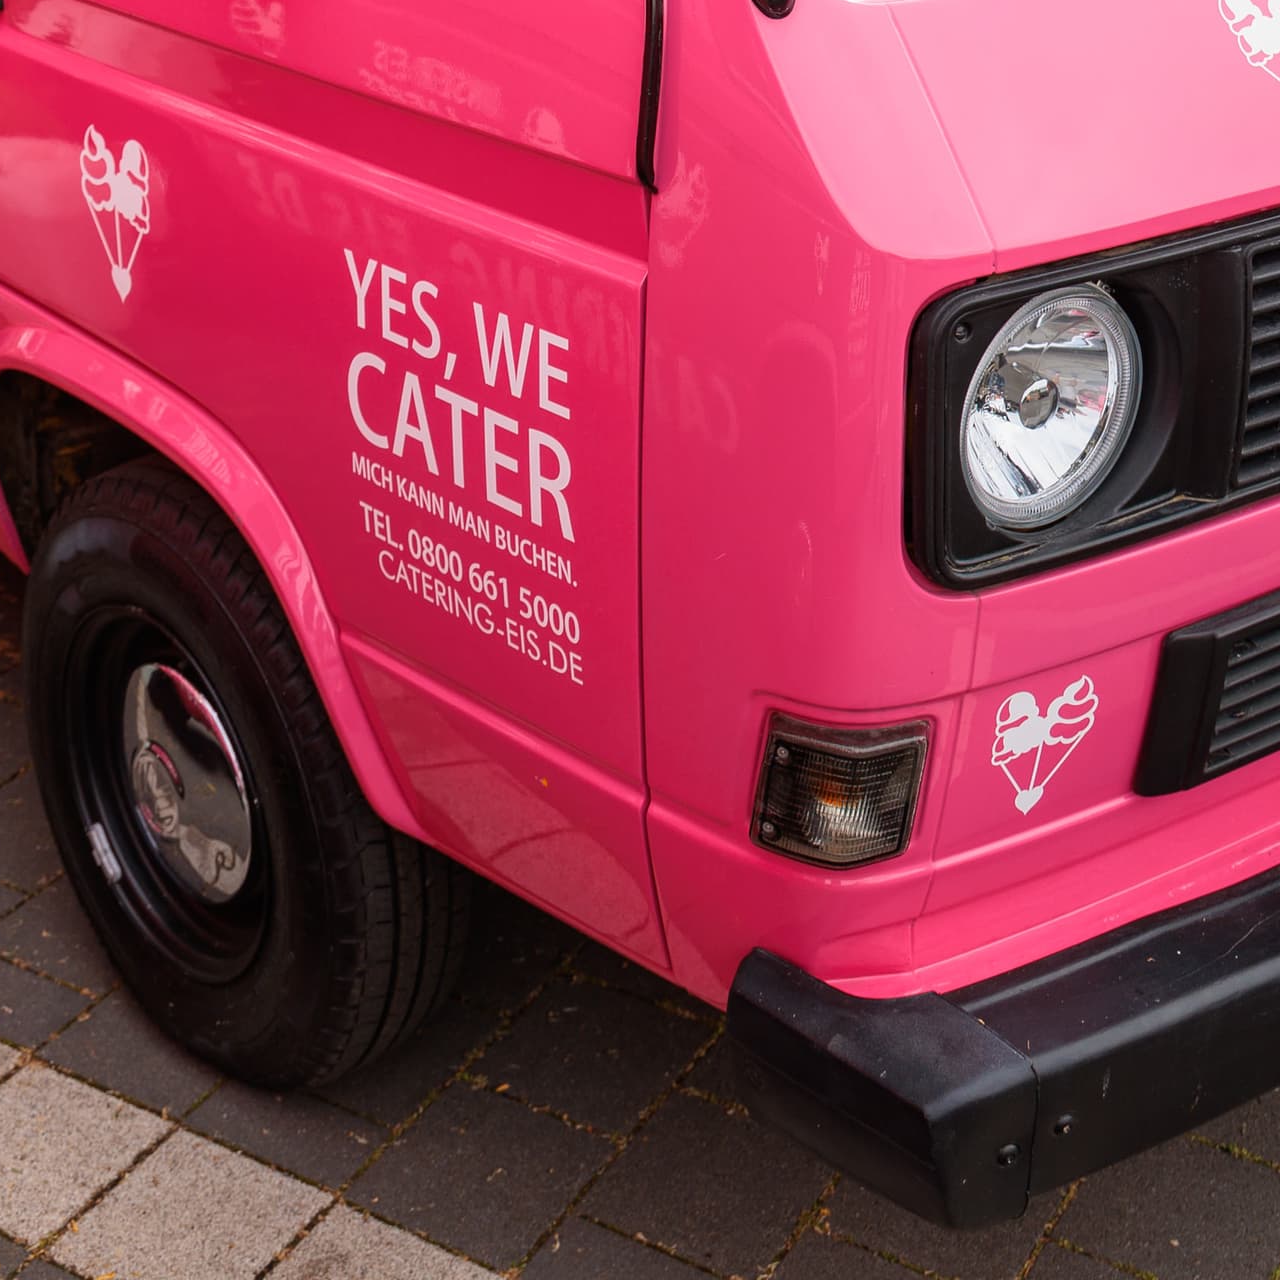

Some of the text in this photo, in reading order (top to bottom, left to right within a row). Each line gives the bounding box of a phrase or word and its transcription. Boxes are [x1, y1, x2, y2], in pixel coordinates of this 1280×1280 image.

[344, 248, 571, 420] YES, WE
[347, 351, 576, 543] CATER
[351, 451, 578, 588] MICH KANN MAN BUCHEN.
[359, 500, 581, 644] TEL. 0800 661 5000
[378, 549, 584, 686] CATERING-EIS.DE
